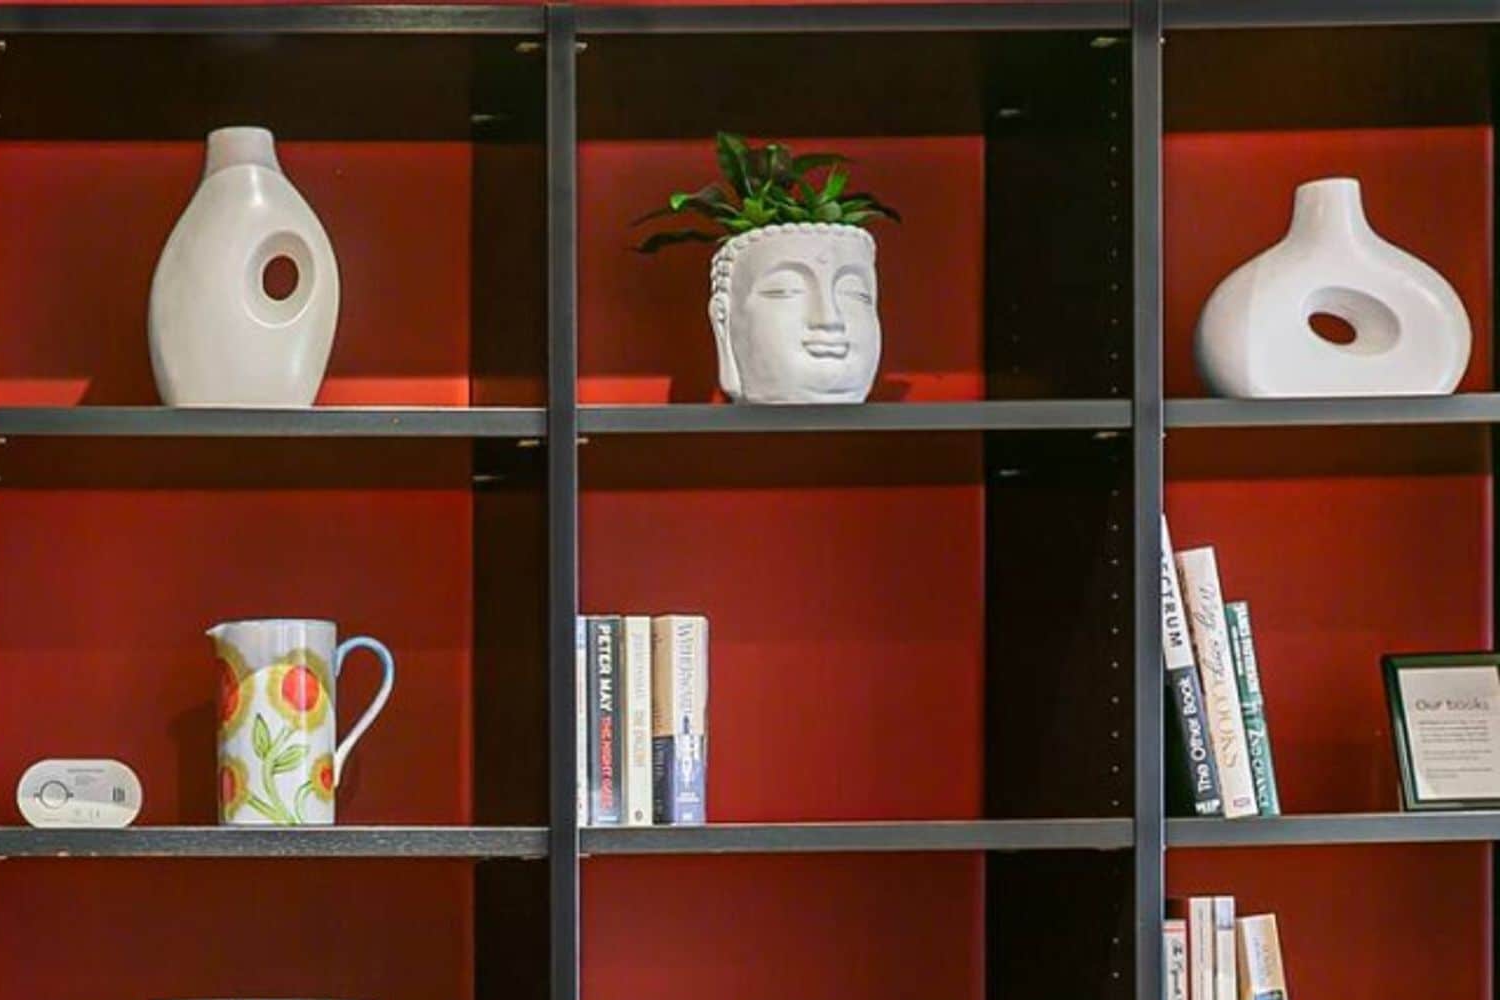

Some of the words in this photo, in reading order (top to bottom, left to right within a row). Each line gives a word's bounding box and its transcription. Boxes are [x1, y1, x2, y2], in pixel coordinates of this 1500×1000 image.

[597, 624, 613, 674] PETER
[599, 679, 613, 712] MAY
[1179, 677, 1197, 715] Book
[1415, 699, 1442, 711] Our
[1445, 697, 1490, 711] books
[1187, 717, 1206, 760] Other
[1197, 764, 1212, 793] The
